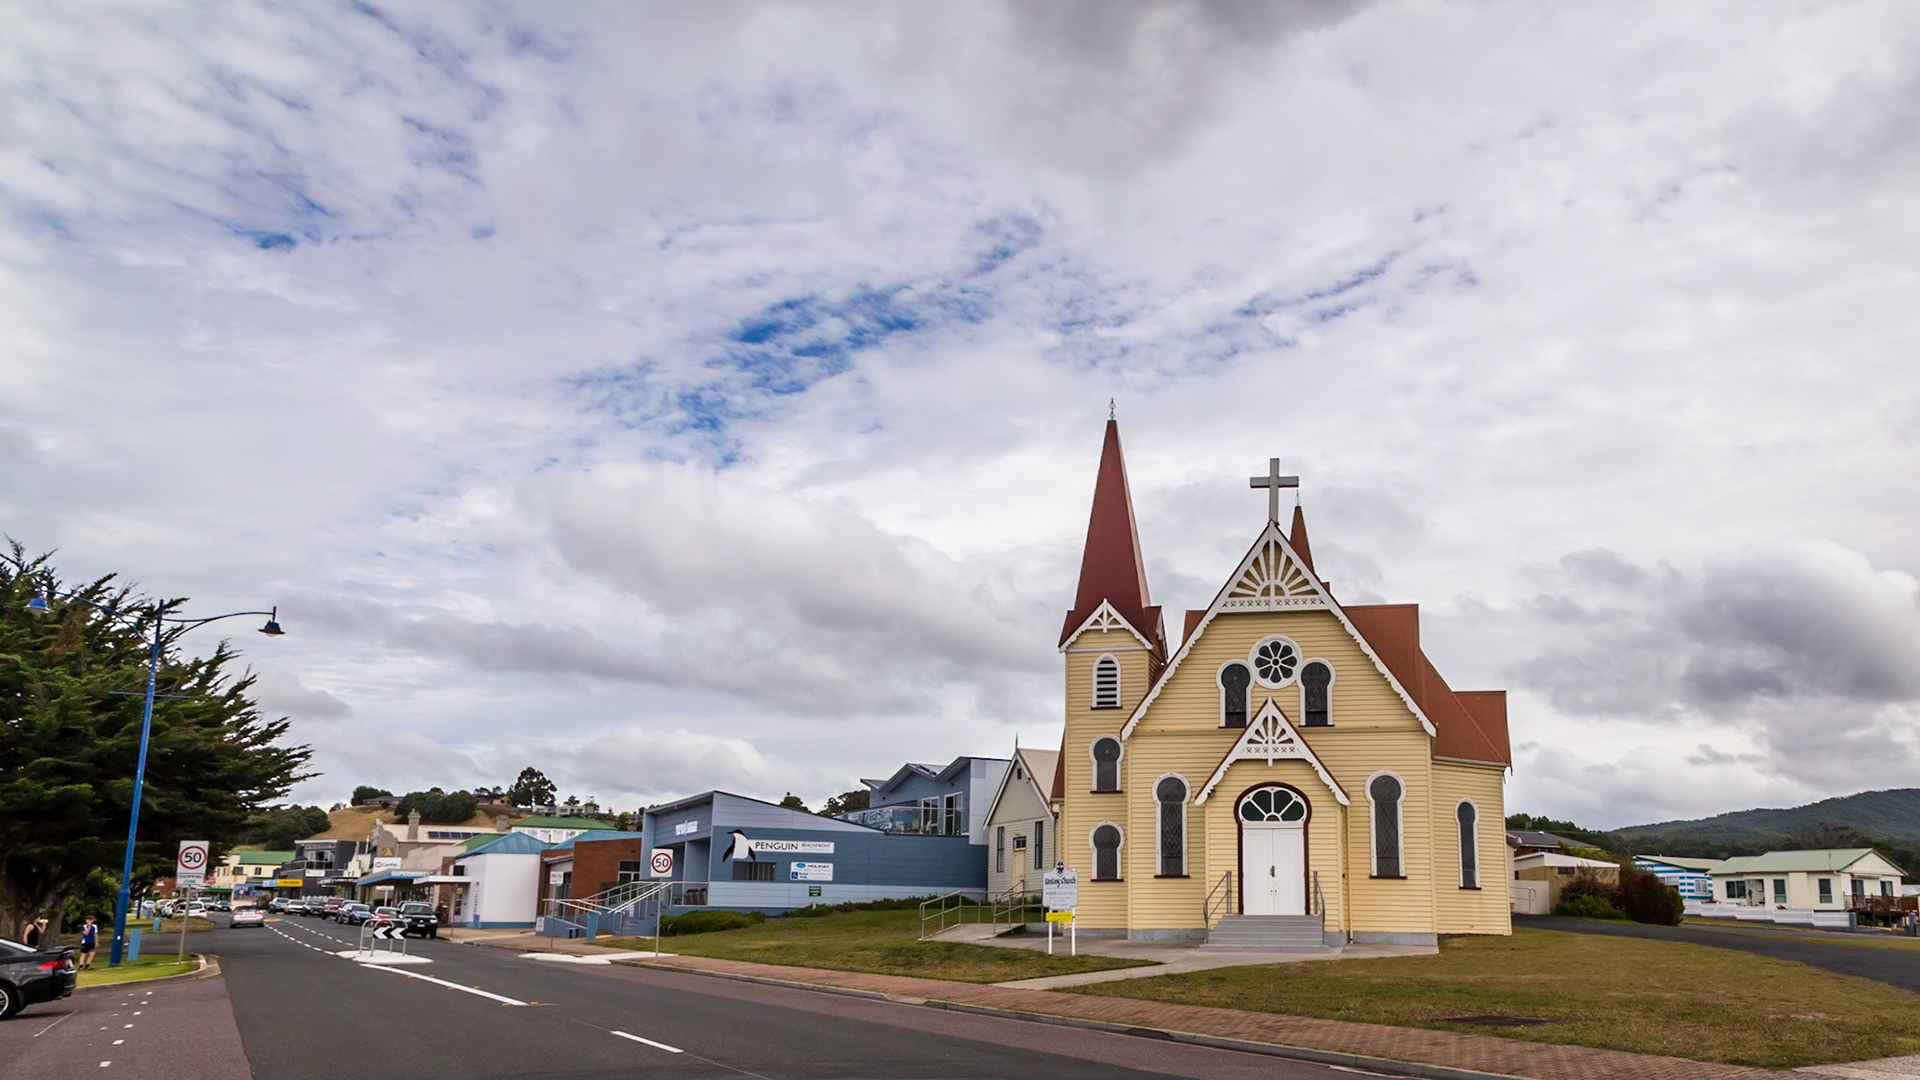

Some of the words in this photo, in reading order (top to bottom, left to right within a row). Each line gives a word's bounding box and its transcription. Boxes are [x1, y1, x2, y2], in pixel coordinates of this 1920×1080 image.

[755, 841, 798, 851] PENGUIN
[184, 852, 202, 863] 50
[655, 857, 669, 868] 50
[1060, 876, 1076, 884] Church
